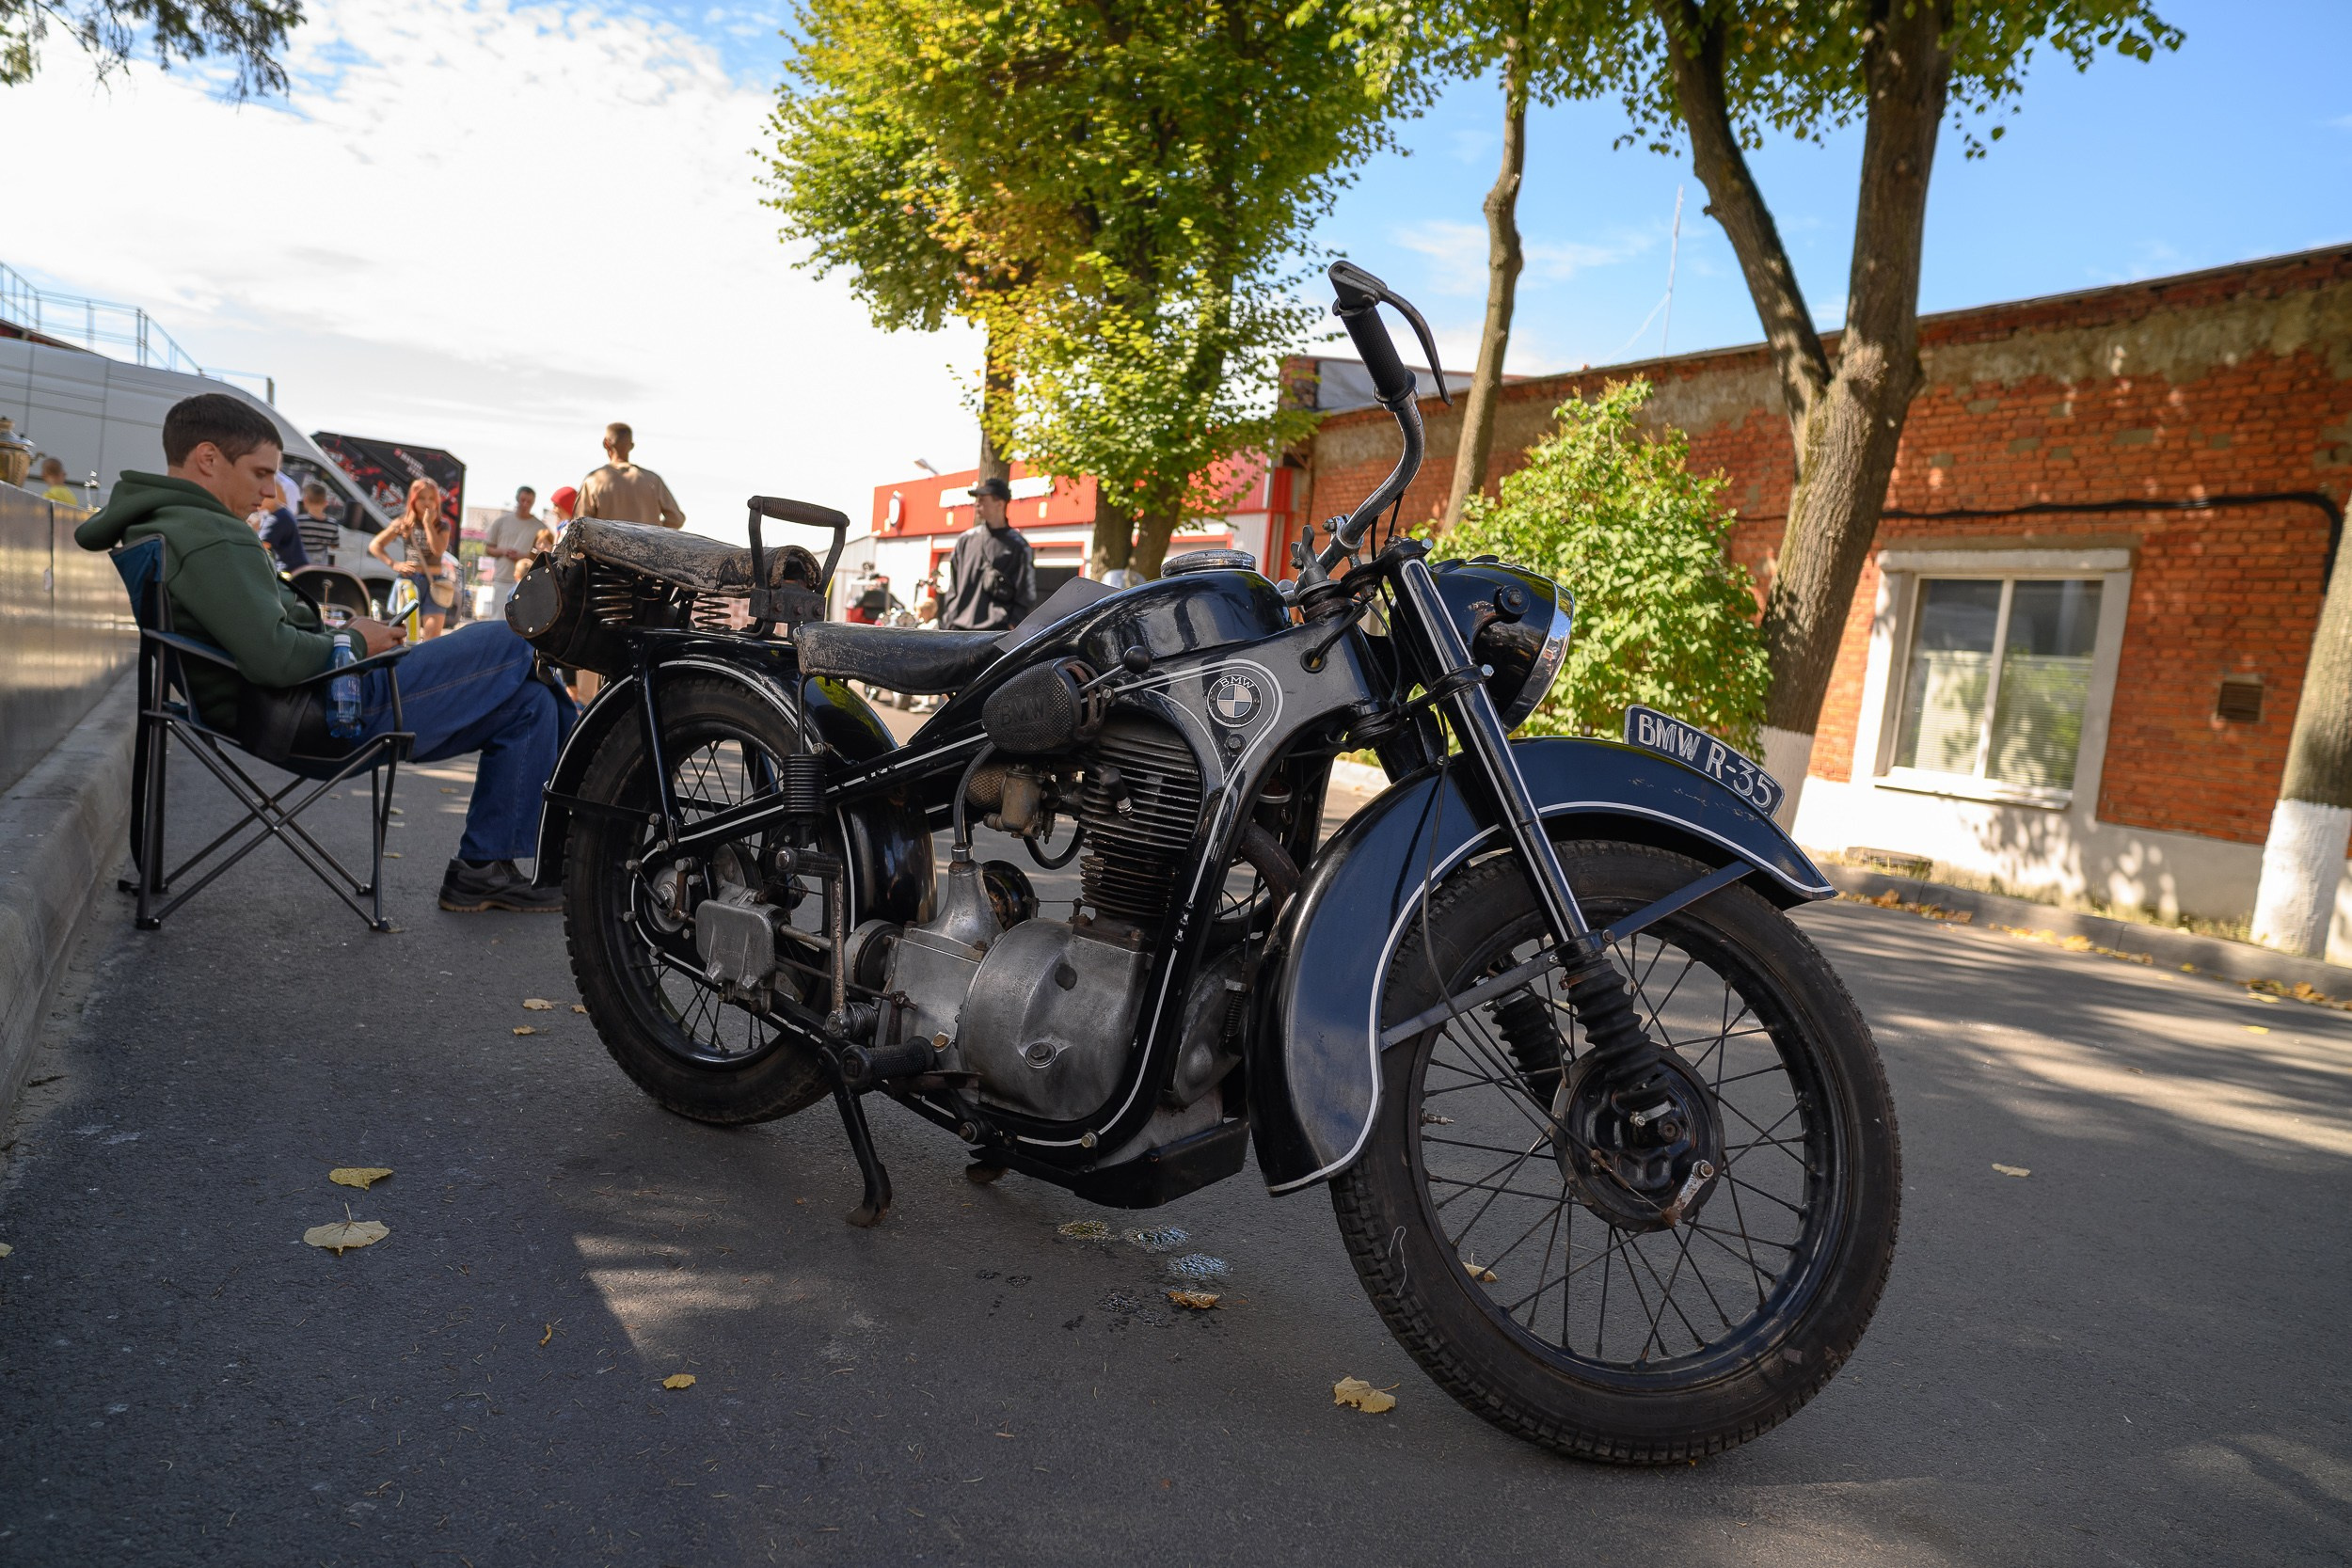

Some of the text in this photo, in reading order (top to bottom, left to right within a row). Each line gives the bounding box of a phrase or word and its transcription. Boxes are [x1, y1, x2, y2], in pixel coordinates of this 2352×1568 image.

[1219, 675, 1254, 689] BMW
[1002, 693, 1045, 725] BMW
[1639, 714, 1774, 808] BMW R-35
